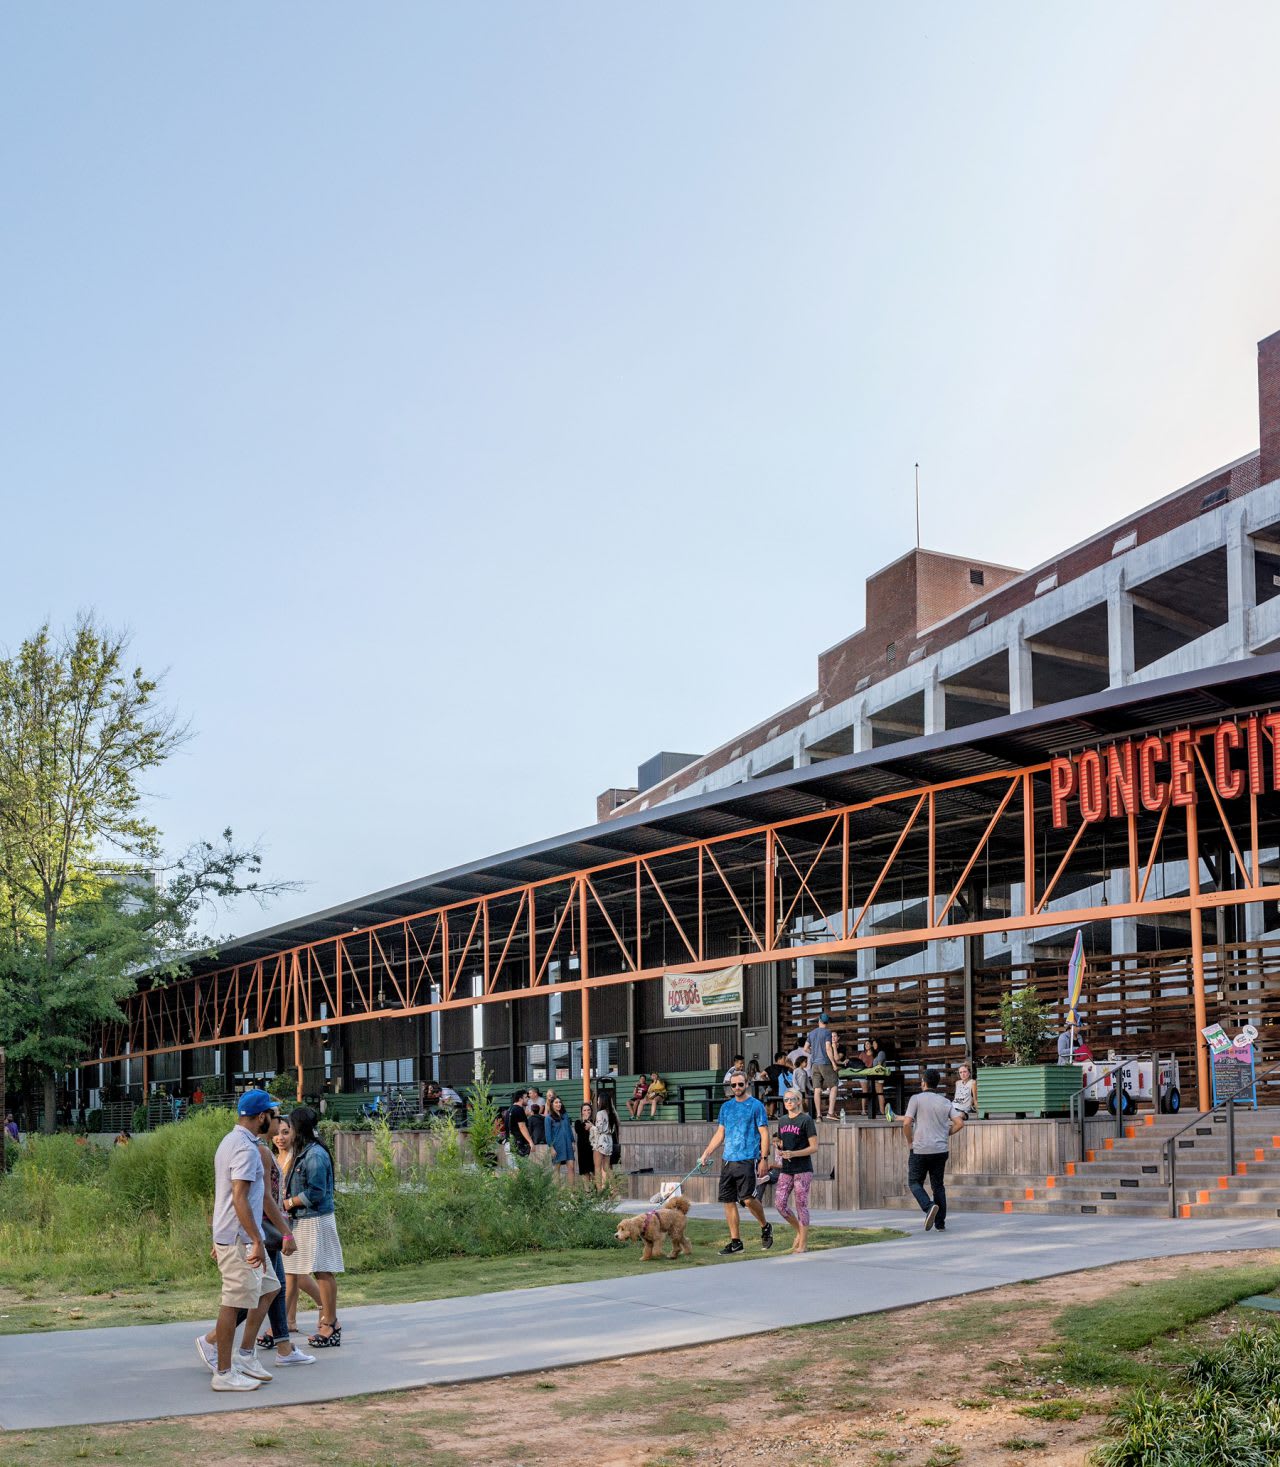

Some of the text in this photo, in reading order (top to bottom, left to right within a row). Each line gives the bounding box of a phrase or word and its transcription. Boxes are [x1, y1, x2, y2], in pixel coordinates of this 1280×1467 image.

[1050, 729, 1198, 829] PONCE
[1112, 1069, 1131, 1078] KNG
[1113, 1081, 1132, 1090] PPS
[780, 1124, 800, 1135] MIAMI
